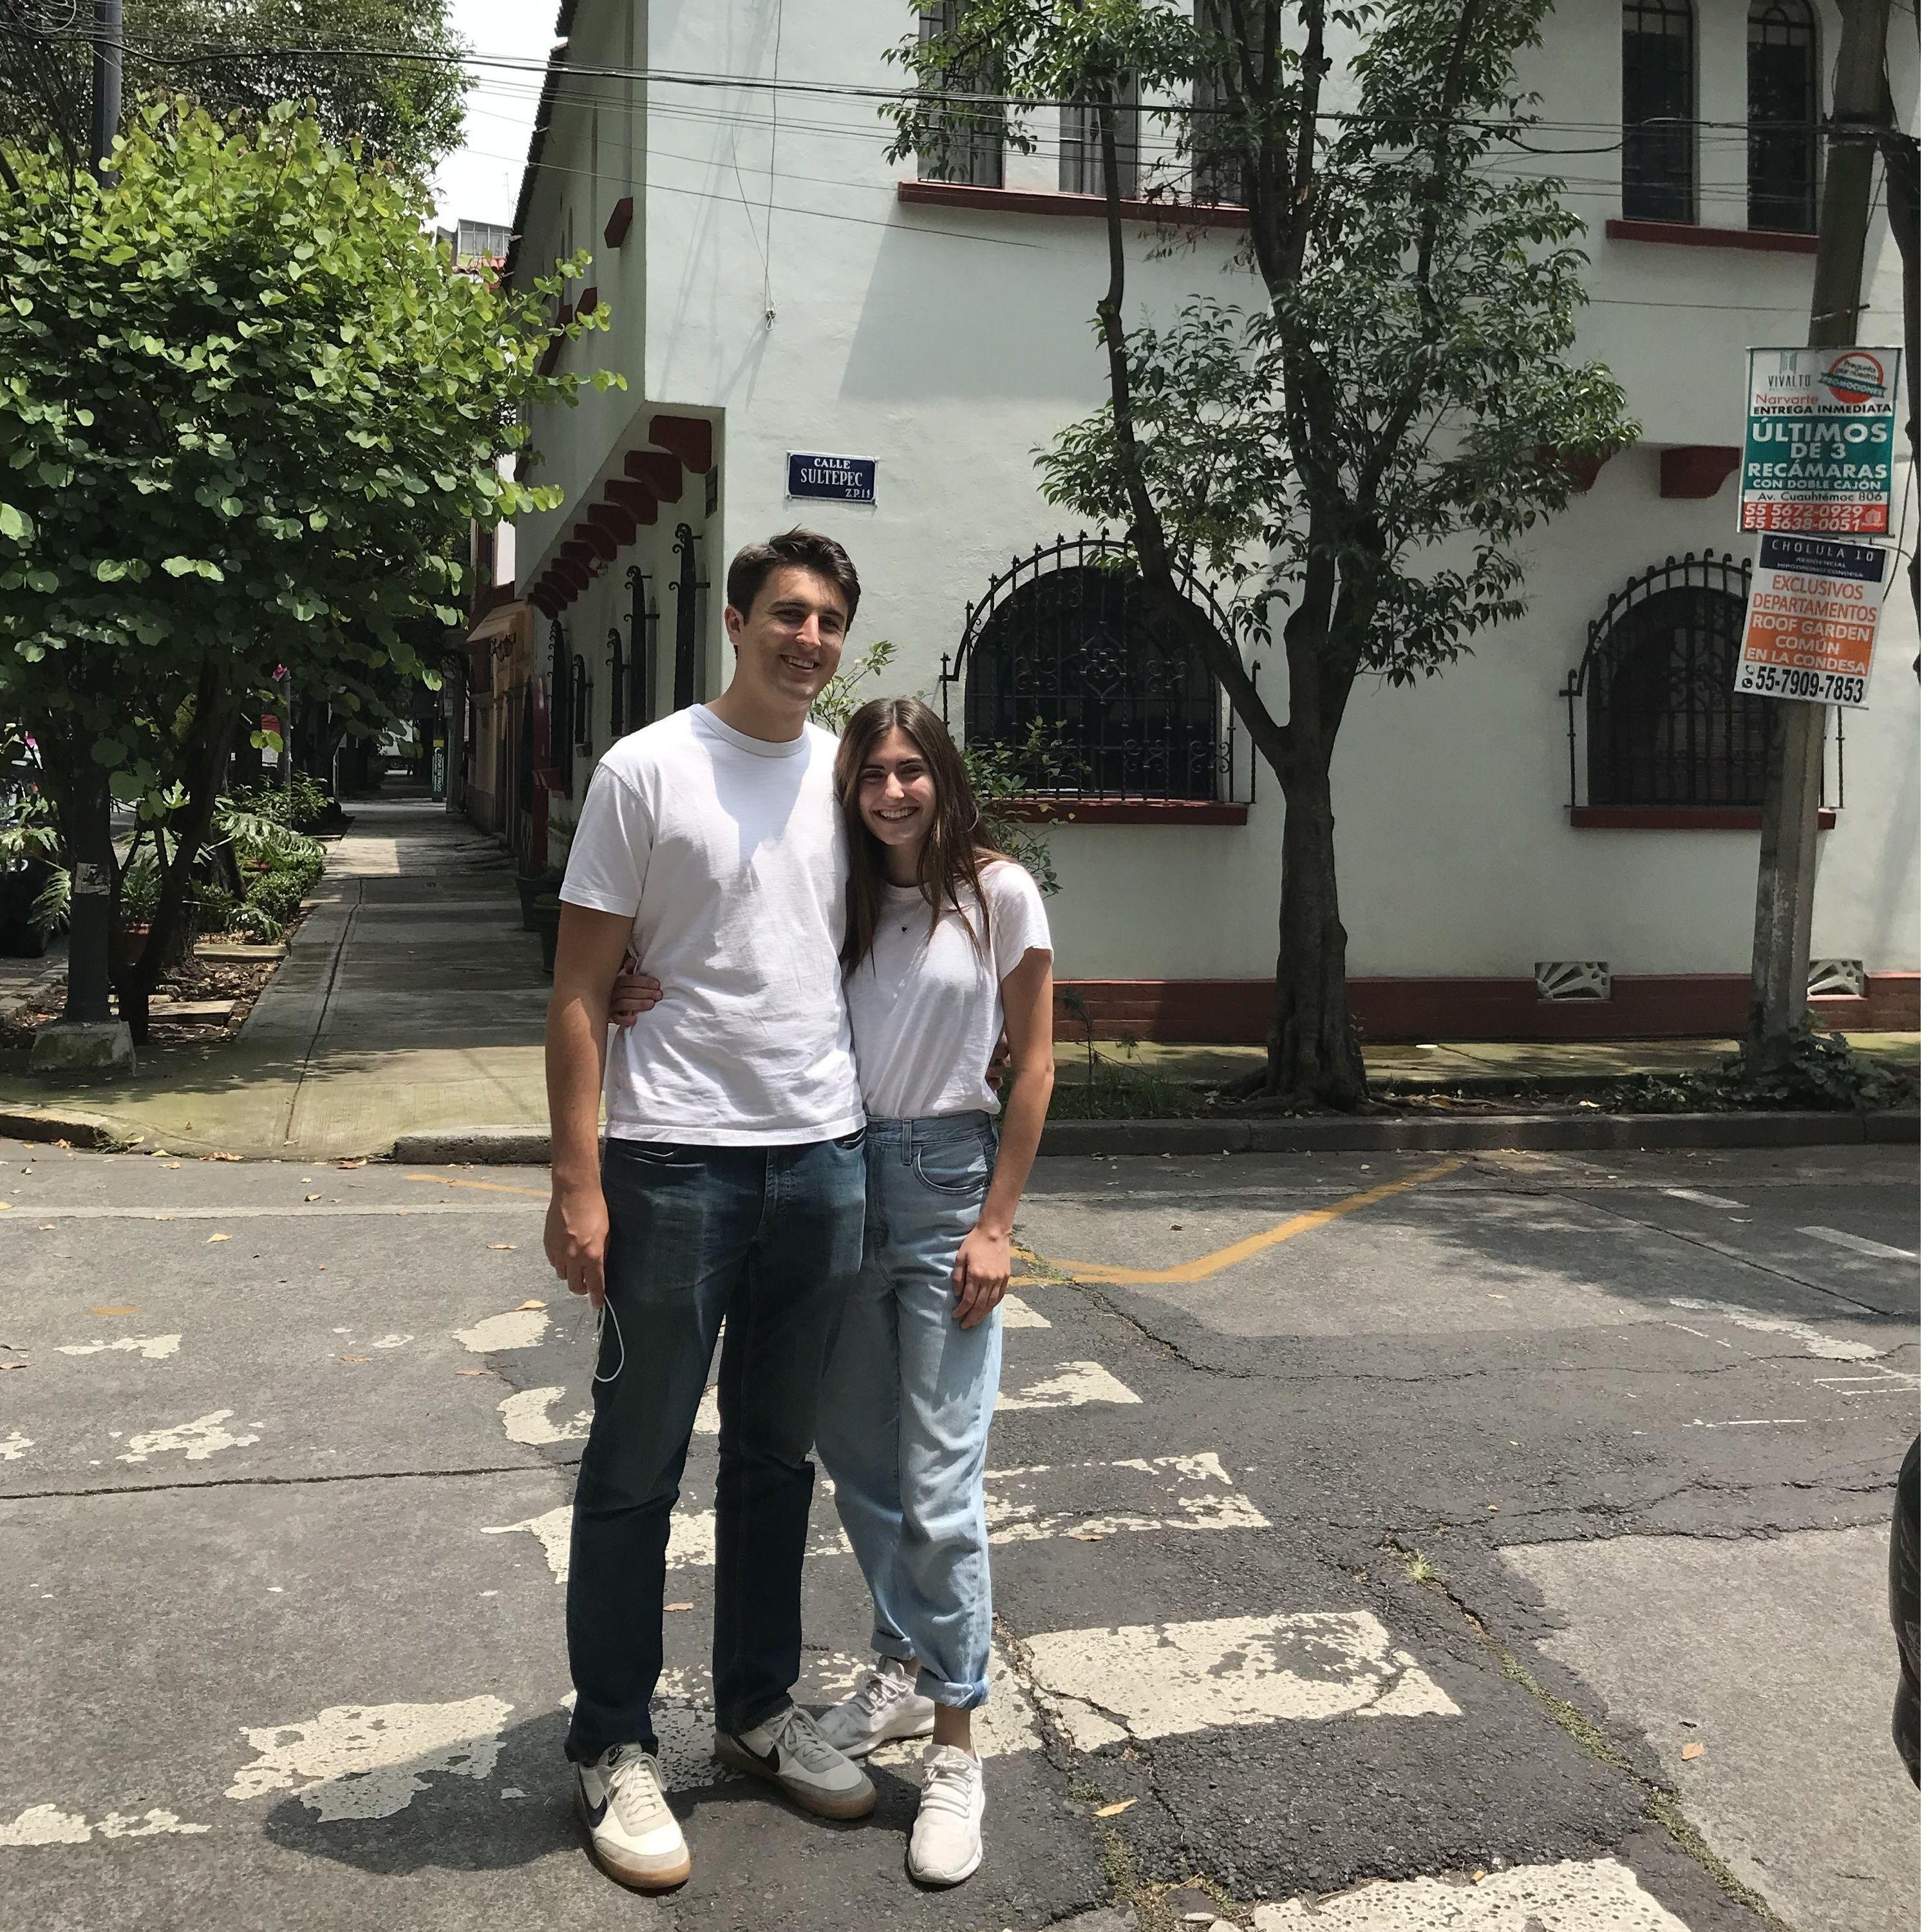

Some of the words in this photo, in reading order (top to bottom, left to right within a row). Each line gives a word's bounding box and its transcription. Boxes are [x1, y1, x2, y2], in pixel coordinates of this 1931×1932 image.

[1768, 375, 1811, 387] VIVALTO
[1755, 393, 1818, 405] Narvarte
[1753, 406, 1812, 415] ENTREGA
[1818, 404, 1892, 414] INMEDIATA
[1752, 417, 1887, 443] ÚLTIMOS
[1790, 442, 1821, 459] DE
[1830, 442, 1847, 459] 3
[814, 458, 851, 469] CALLE
[1747, 459, 1887, 479] RECÁMARAS
[800, 468, 863, 487] SULTEPEC
[1753, 478, 1783, 489] CON
[1787, 479, 1829, 489] DOBLE
[1834, 478, 1881, 490] CAJÓN
[1758, 492, 1776, 502] Av.
[1780, 491, 1854, 502] Cuauhtémoc
[1858, 491, 1882, 502] 806
[1744, 504, 1766, 516] 55
[1771, 504, 1863, 518] 5672-0929
[1744, 516, 1766, 529] 55
[1770, 517, 1861, 532] 5638-0051
[1772, 539, 1845, 558] CHOLULA
[1855, 551, 1874, 562] 10
[1772, 574, 1864, 600] EXCLUSIVOS
[1752, 592, 1878, 623] DEPARTAMENTOS
[1752, 614, 1798, 632] ROOF
[1801, 620, 1870, 641] GARDEN
[1775, 634, 1840, 655] COMÚN
[1747, 647, 1767, 661] EN
[1771, 651, 1789, 664] LA
[1793, 654, 1866, 674] CONDESA
[1755, 665, 1865, 703] 55-7909-7853
